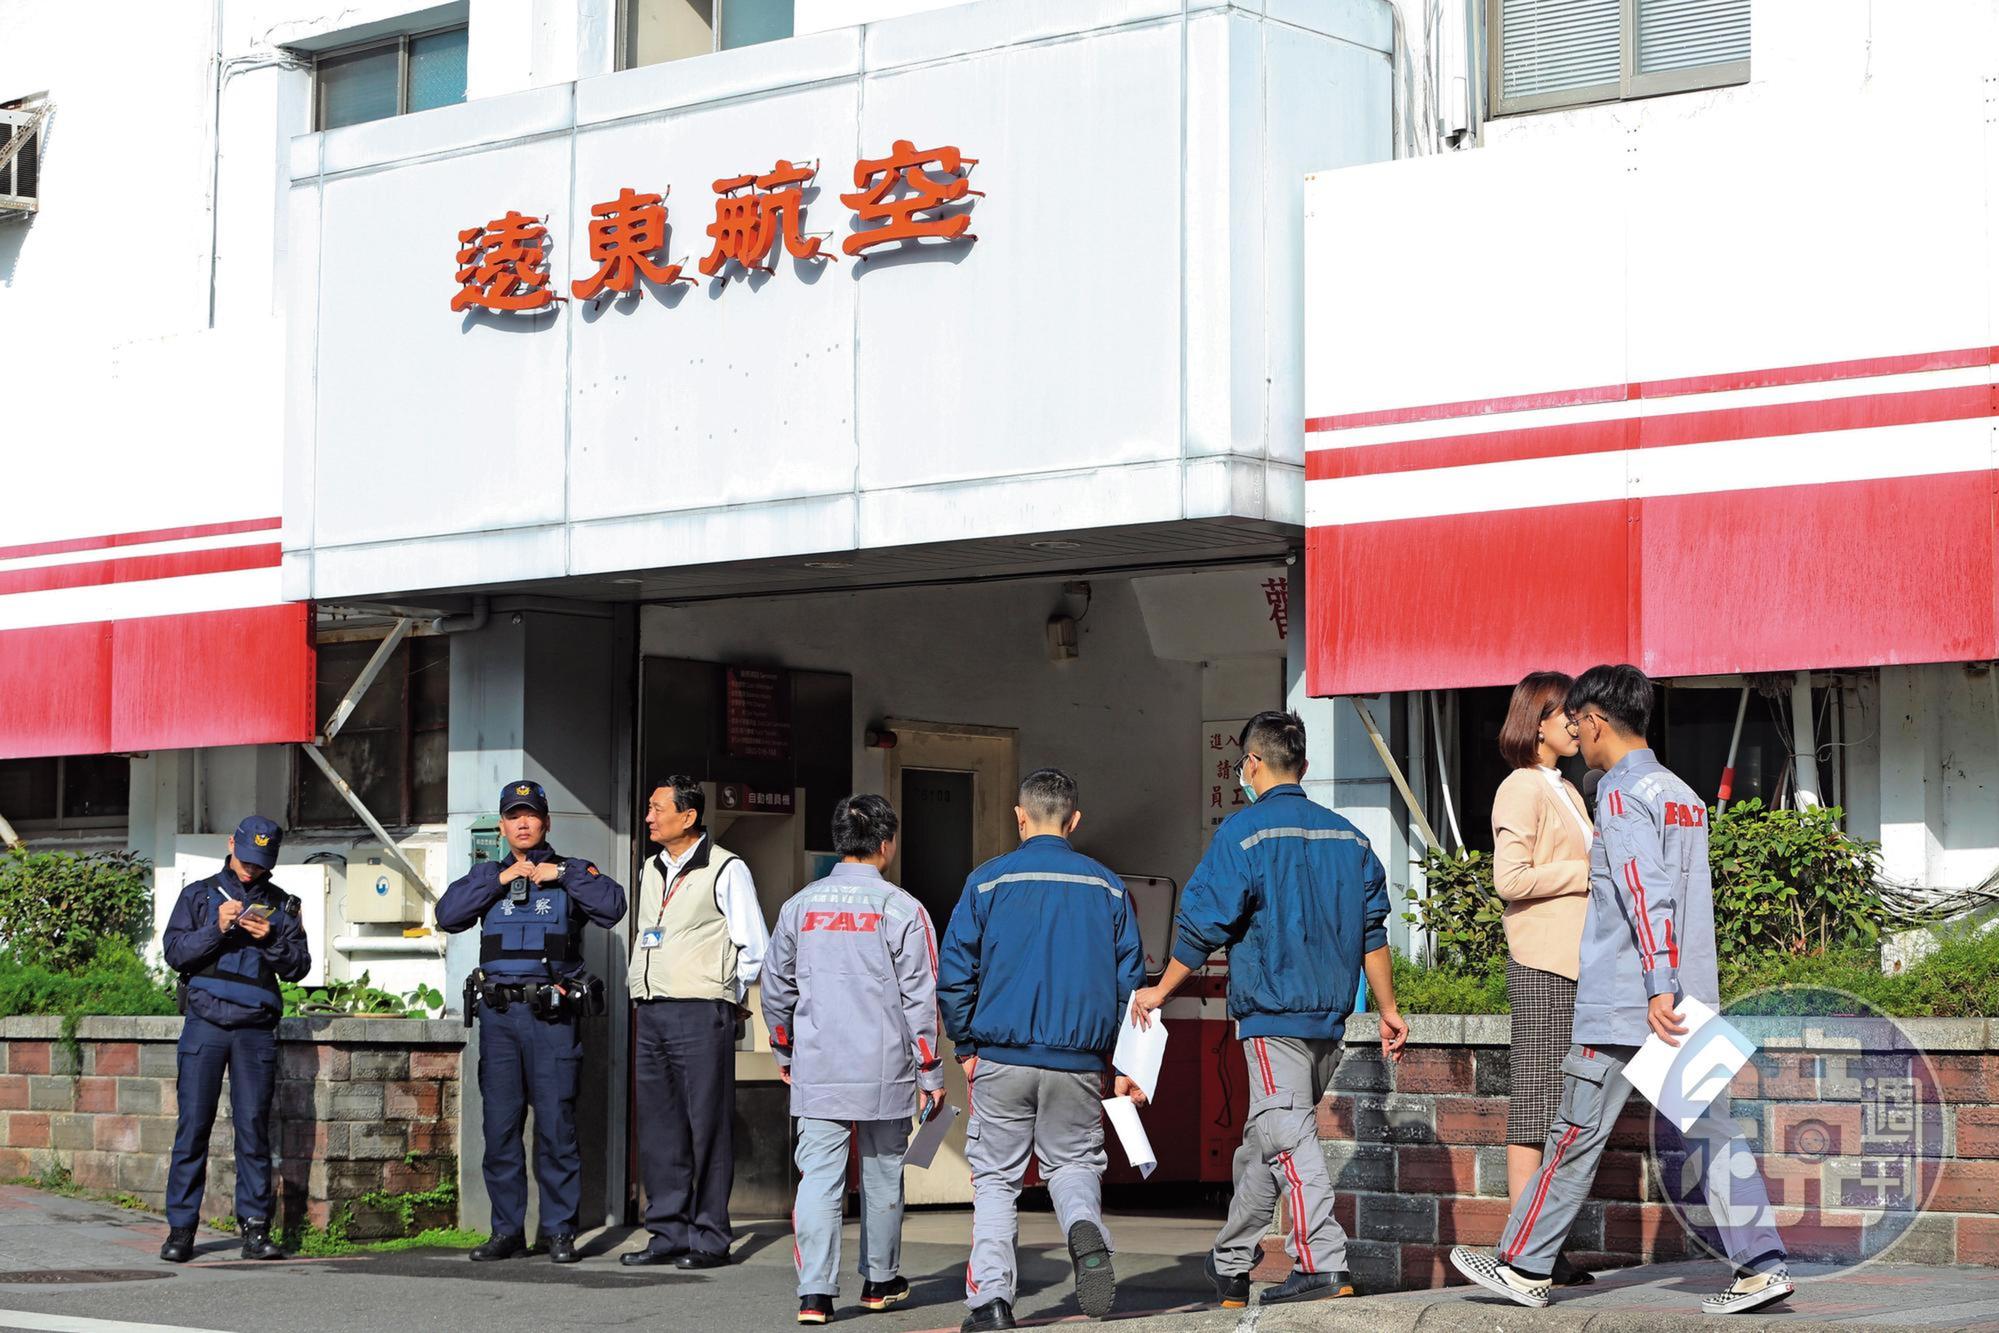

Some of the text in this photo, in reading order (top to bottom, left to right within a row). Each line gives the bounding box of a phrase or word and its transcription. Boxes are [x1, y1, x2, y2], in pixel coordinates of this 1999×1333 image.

[451, 139, 975, 311] 遠東航空
[1664, 801, 1706, 827] FAT
[502, 898, 552, 915] 警察
[800, 911, 882, 932] FAT
